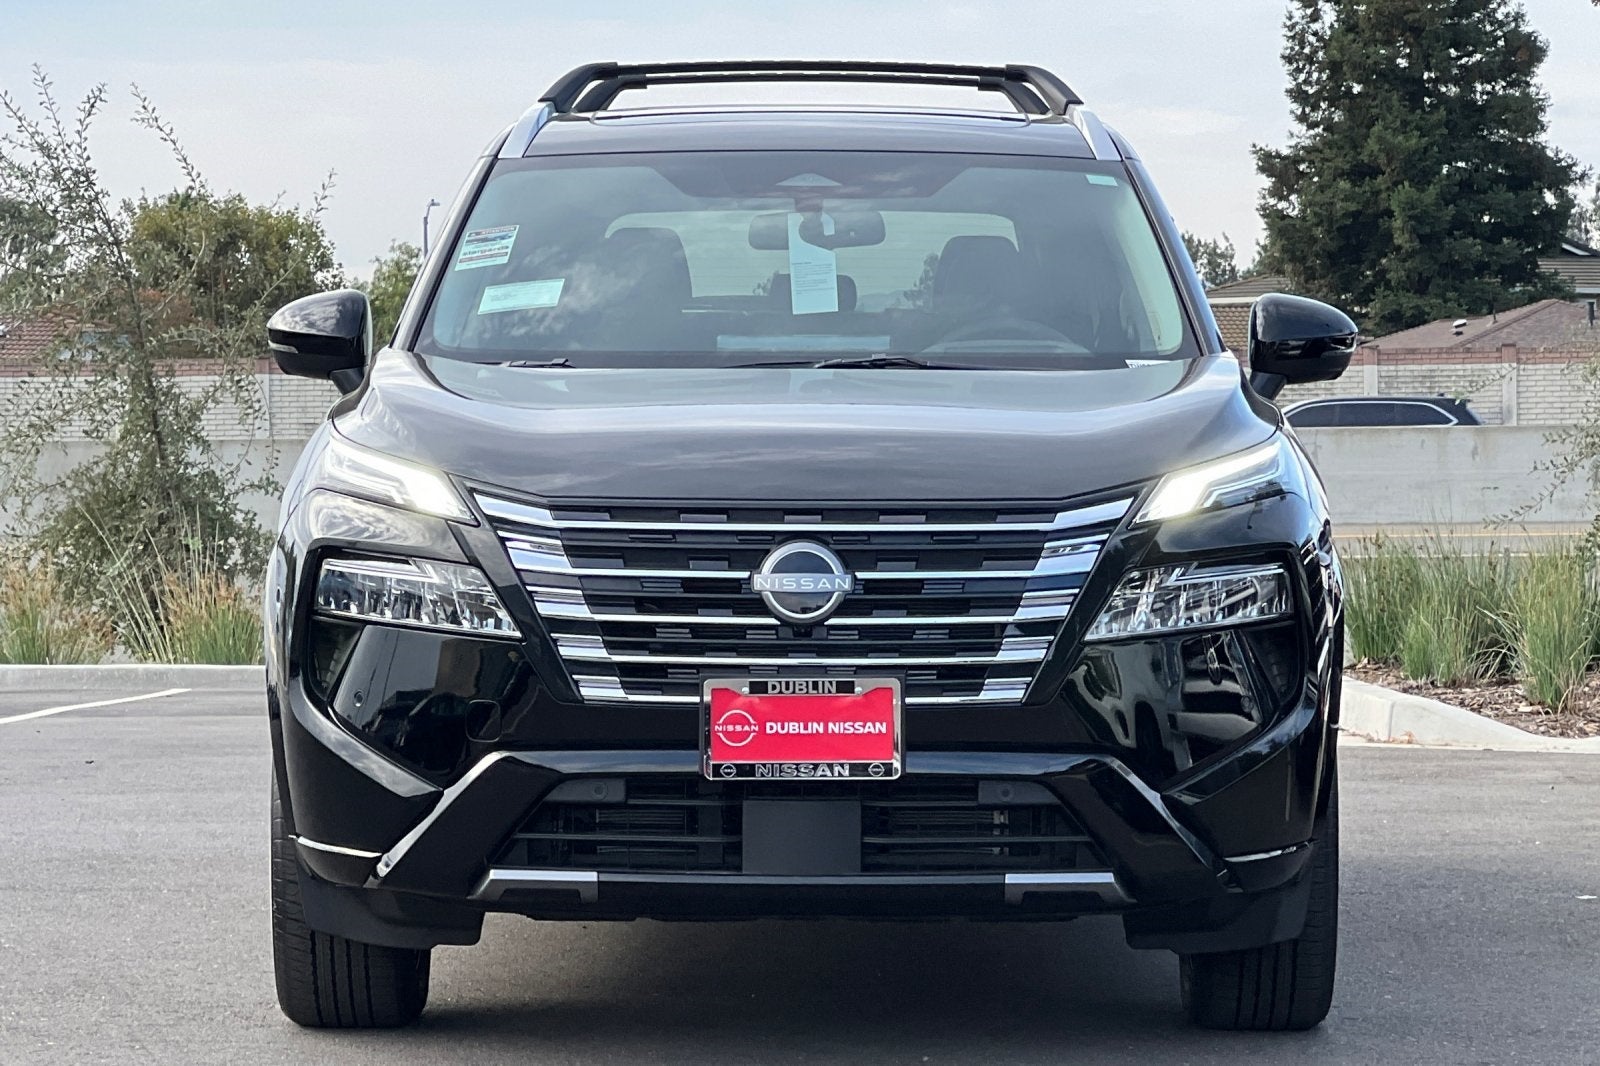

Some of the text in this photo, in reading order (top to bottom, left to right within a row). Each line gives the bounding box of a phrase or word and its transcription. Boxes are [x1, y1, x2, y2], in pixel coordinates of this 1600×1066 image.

[757, 578, 848, 589] NISSAN
[767, 680, 837, 694] DUBLIN
[714, 724, 759, 732] NISSAN
[765, 722, 886, 734] DUBLIN NISSAN
[755, 763, 850, 777] NISSAN
